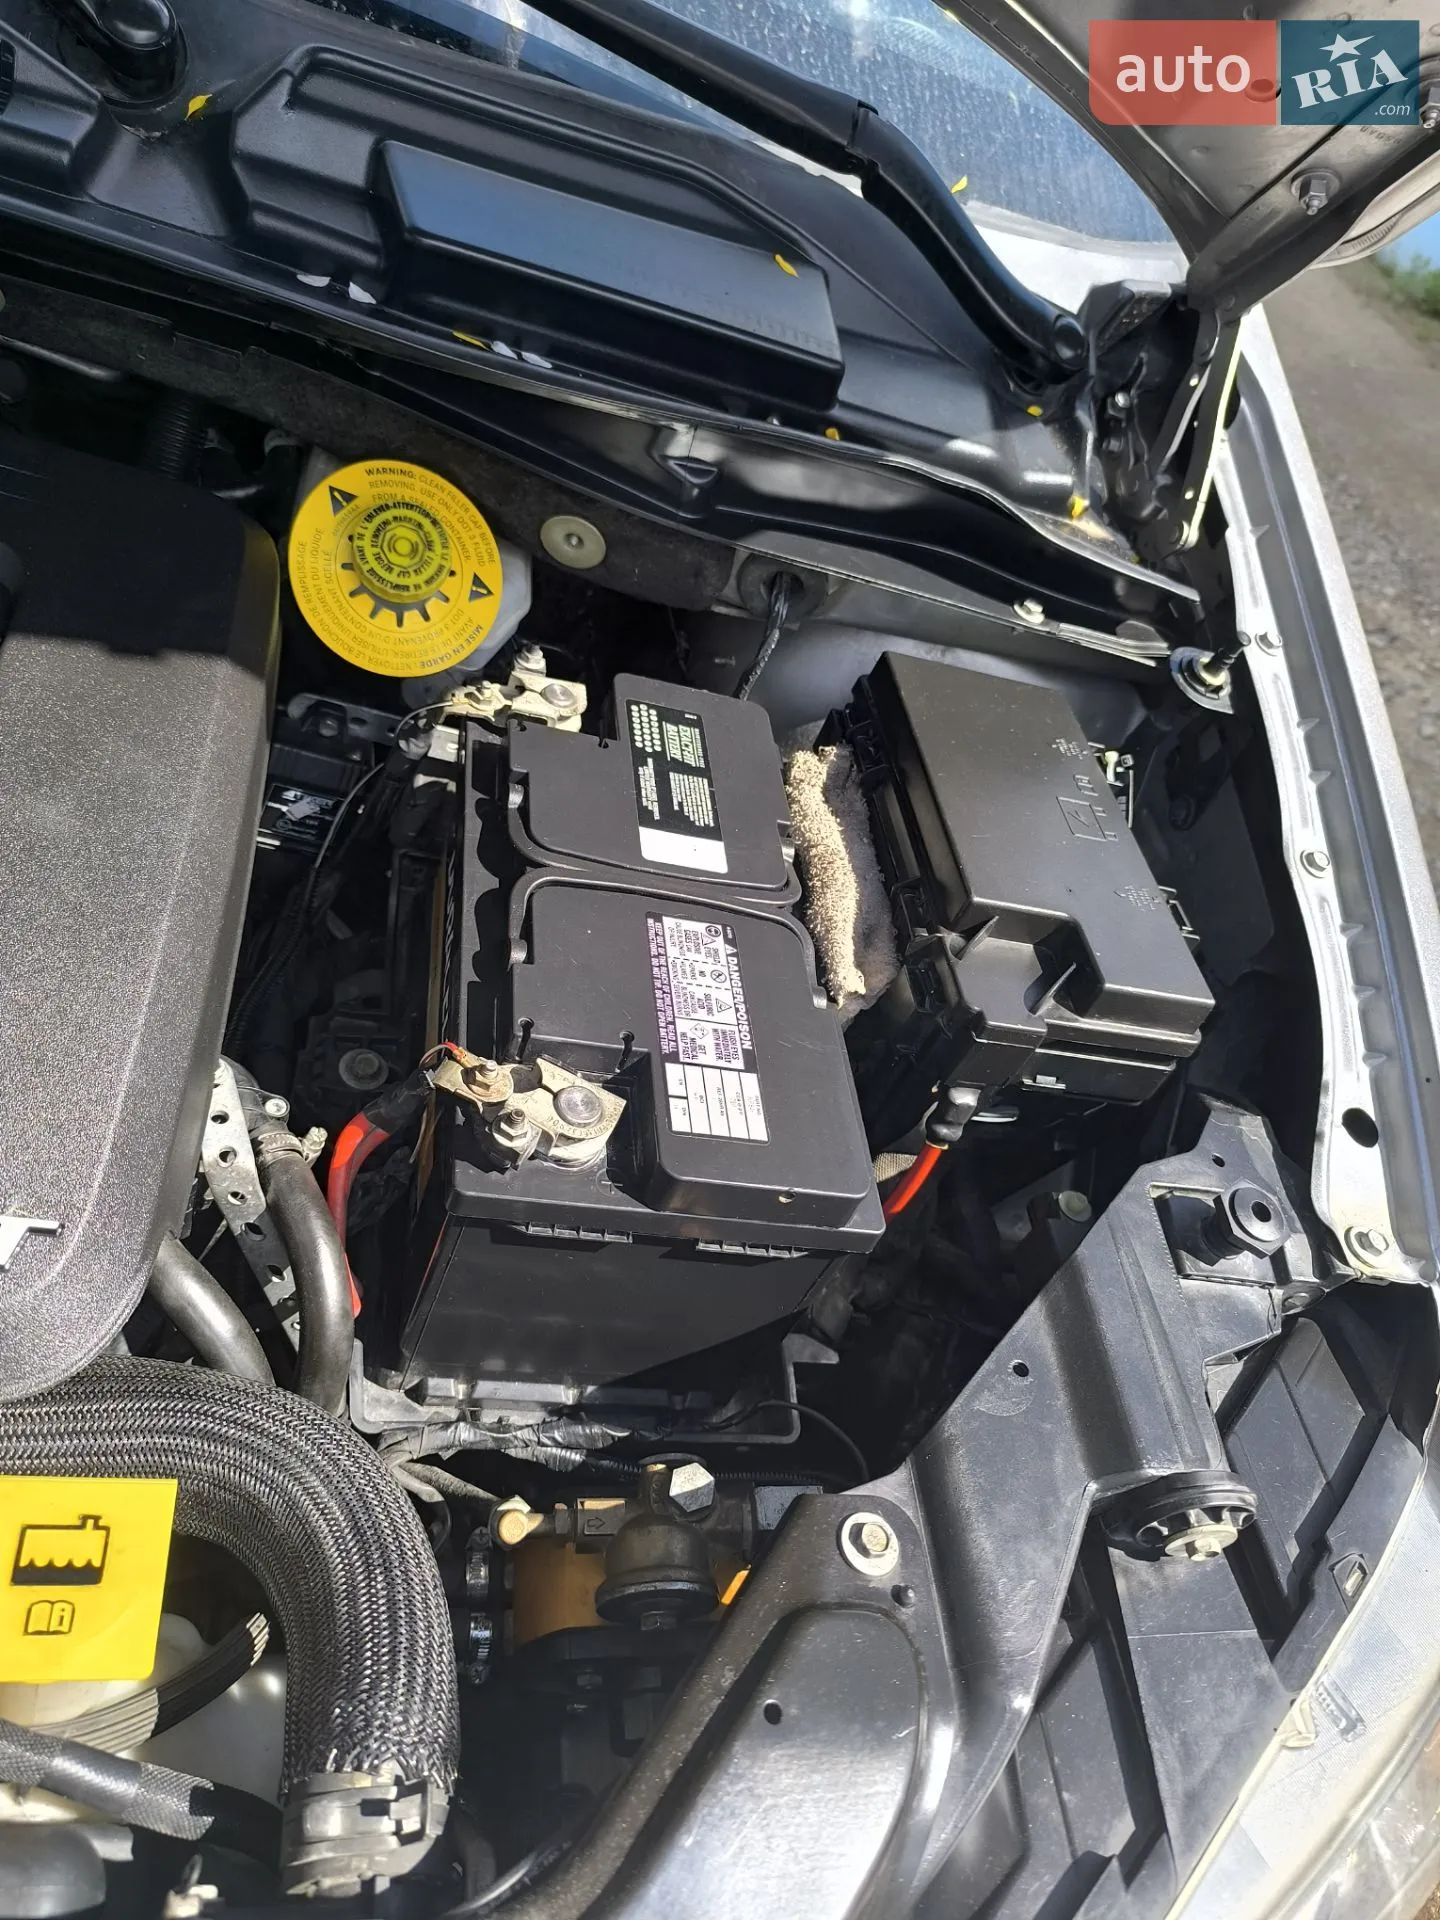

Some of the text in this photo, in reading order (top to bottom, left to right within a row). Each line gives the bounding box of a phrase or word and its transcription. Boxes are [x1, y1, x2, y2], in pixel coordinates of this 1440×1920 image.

[666, 722, 682, 761] BATTERY
[678, 724, 696, 767] EXACT-FIT
[654, 921, 663, 935] KEEP
[656, 935, 664, 946] OUT
[657, 947, 665, 955] OF
[651, 957, 659, 966] DO
[658, 955, 666, 966] THE
[652, 966, 660, 978] NOT
[659, 966, 669, 984] REACH
[698, 969, 706, 977] NO
[662, 984, 670, 993] OF
[656, 998, 664, 1010] NOT
[726, 955, 752, 1050] DANGER/POISON
[657, 1011, 666, 1027] OPEN
[666, 1024, 676, 1040] READ
[711, 1027, 720, 1041] WITH
[668, 1040, 677, 1052] ALL
[679, 1031, 691, 1061] HELP FAST.
[688, 1036, 699, 1061] MEDICAL
[697, 1044, 706, 1055] GET
[719, 1028, 731, 1064] IMMEDIATELY
[727, 1029, 739, 1060] FLUSH EYES
